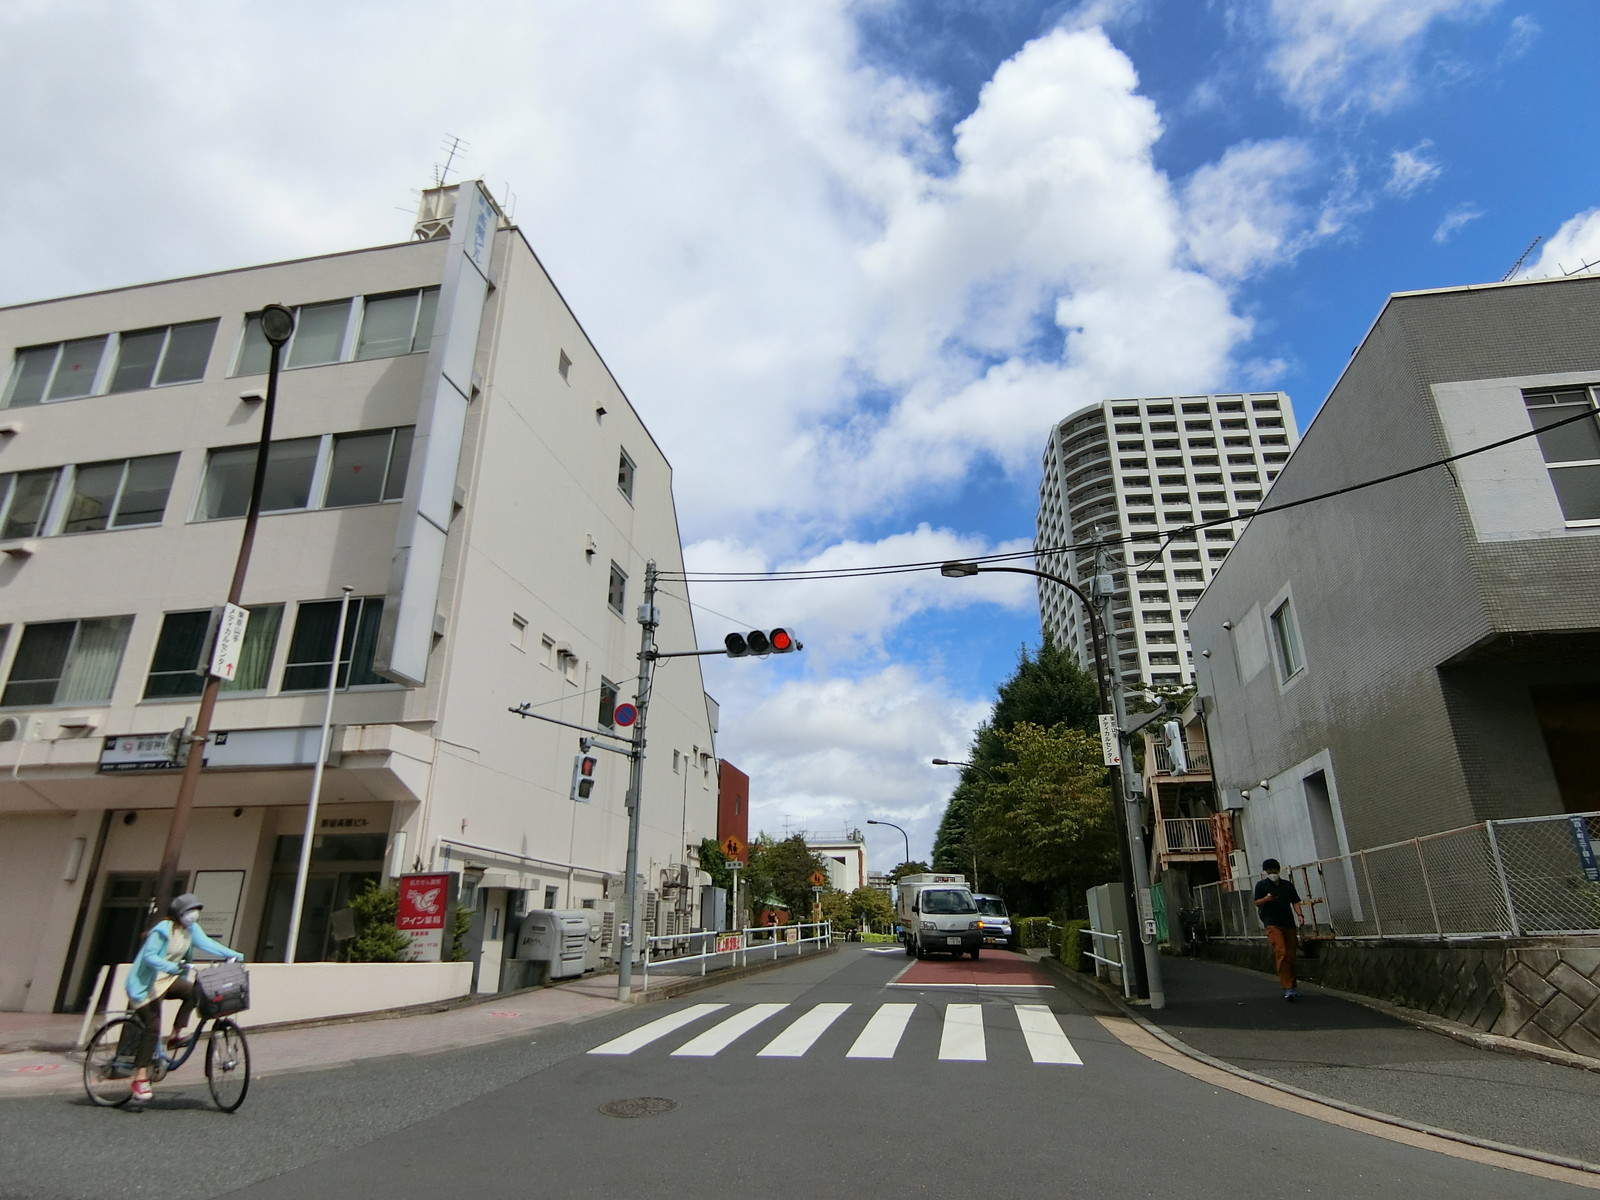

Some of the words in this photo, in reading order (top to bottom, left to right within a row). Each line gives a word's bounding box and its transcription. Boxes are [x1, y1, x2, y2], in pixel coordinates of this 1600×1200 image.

[217, 608, 236, 674] メディカルセンター
[1103, 716, 1113, 764] メディカルセンター
[401, 915, 441, 926] アイン薬局
